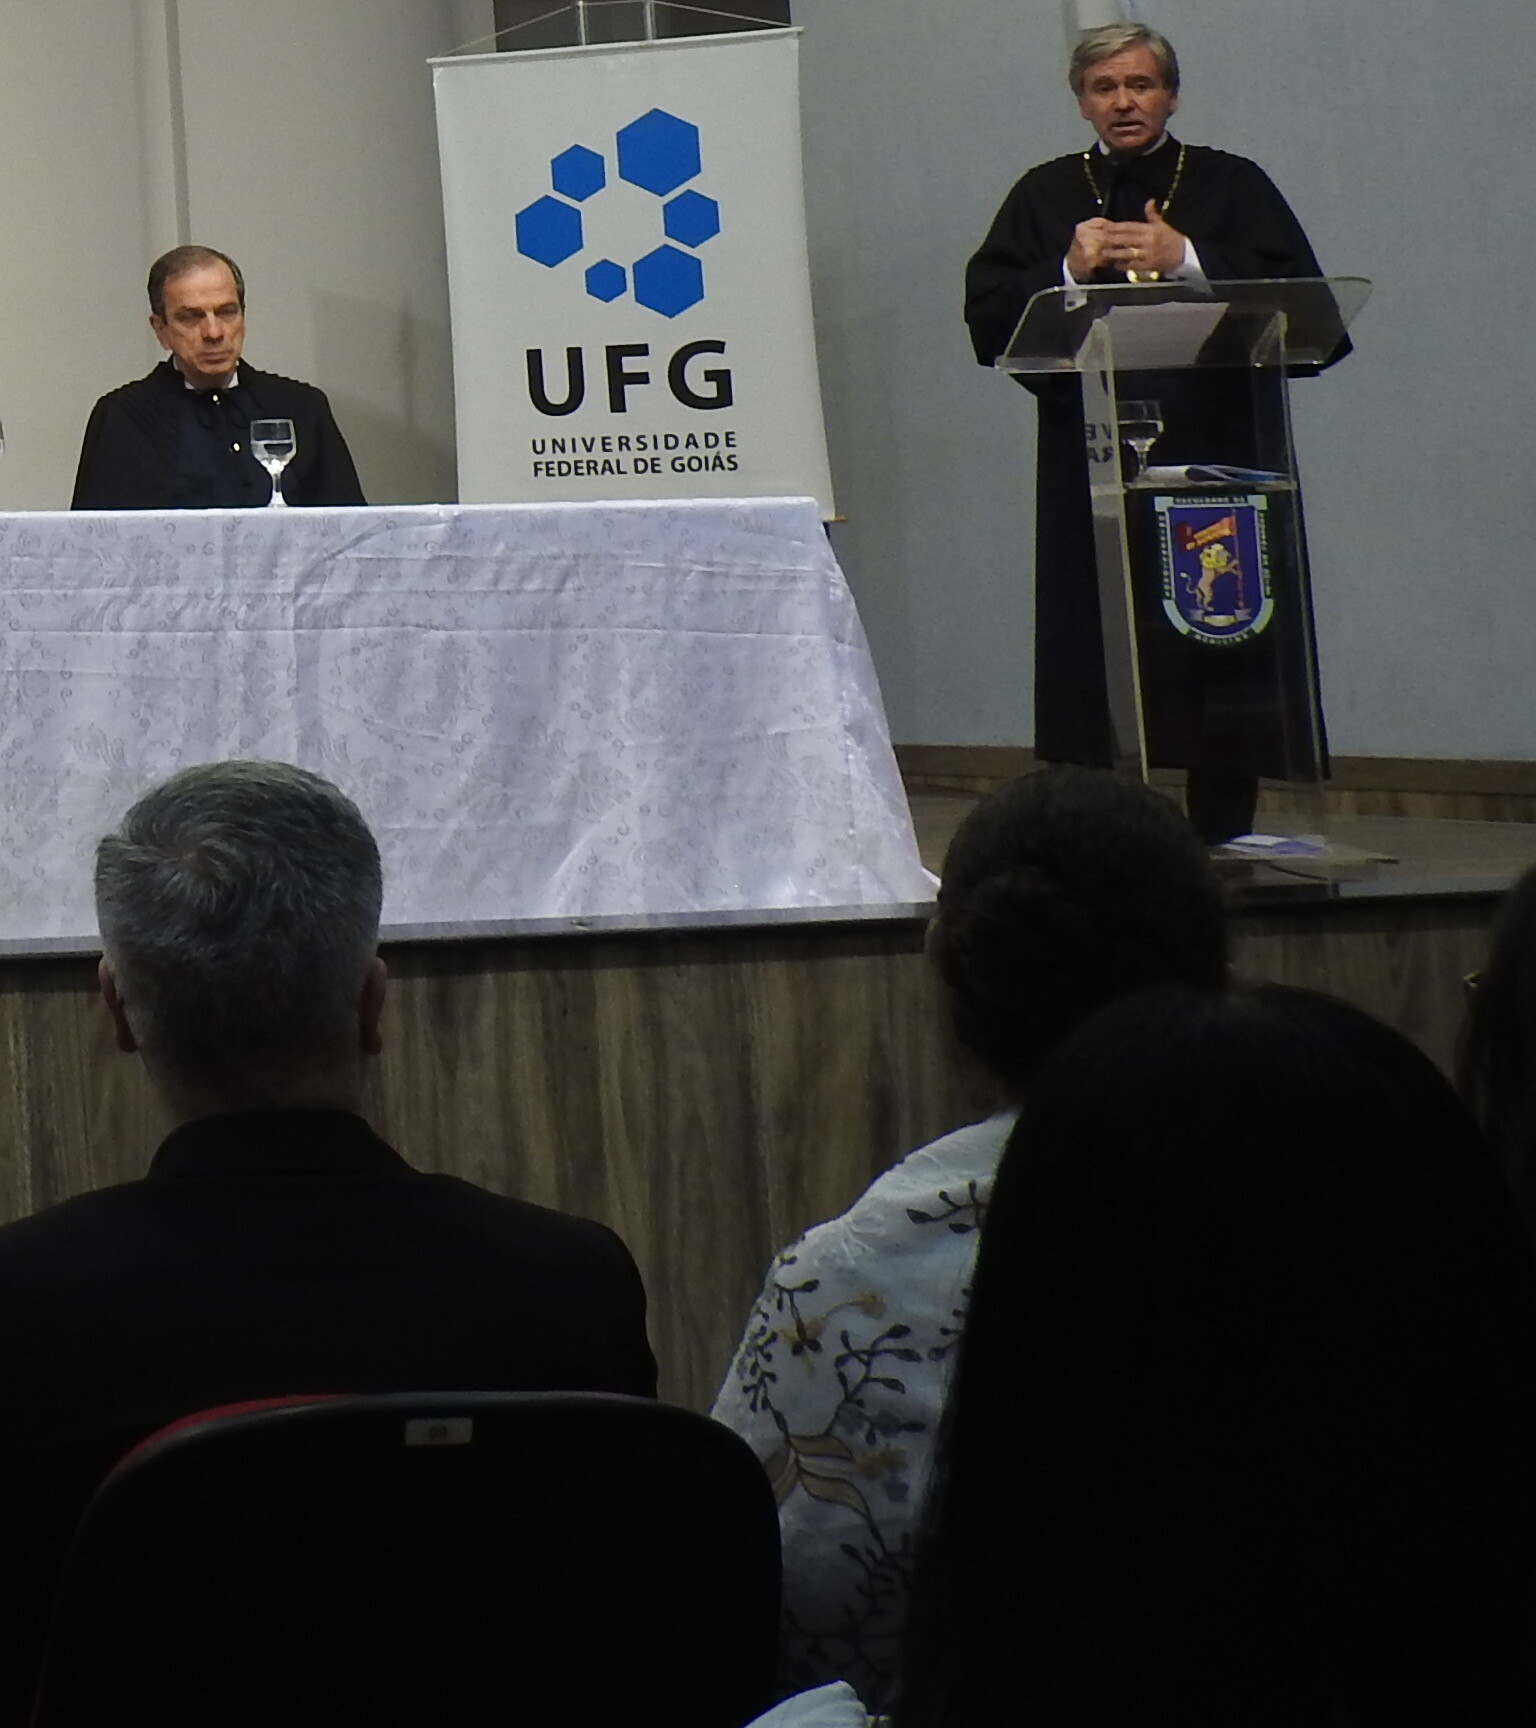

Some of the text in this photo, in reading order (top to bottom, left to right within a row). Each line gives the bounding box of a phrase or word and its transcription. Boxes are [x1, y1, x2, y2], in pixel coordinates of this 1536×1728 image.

[526, 339, 734, 417] UFG
[531, 431, 737, 455] UNIVERSIDADE
[533, 451, 739, 478] FEDERAL DE GOIÁS
